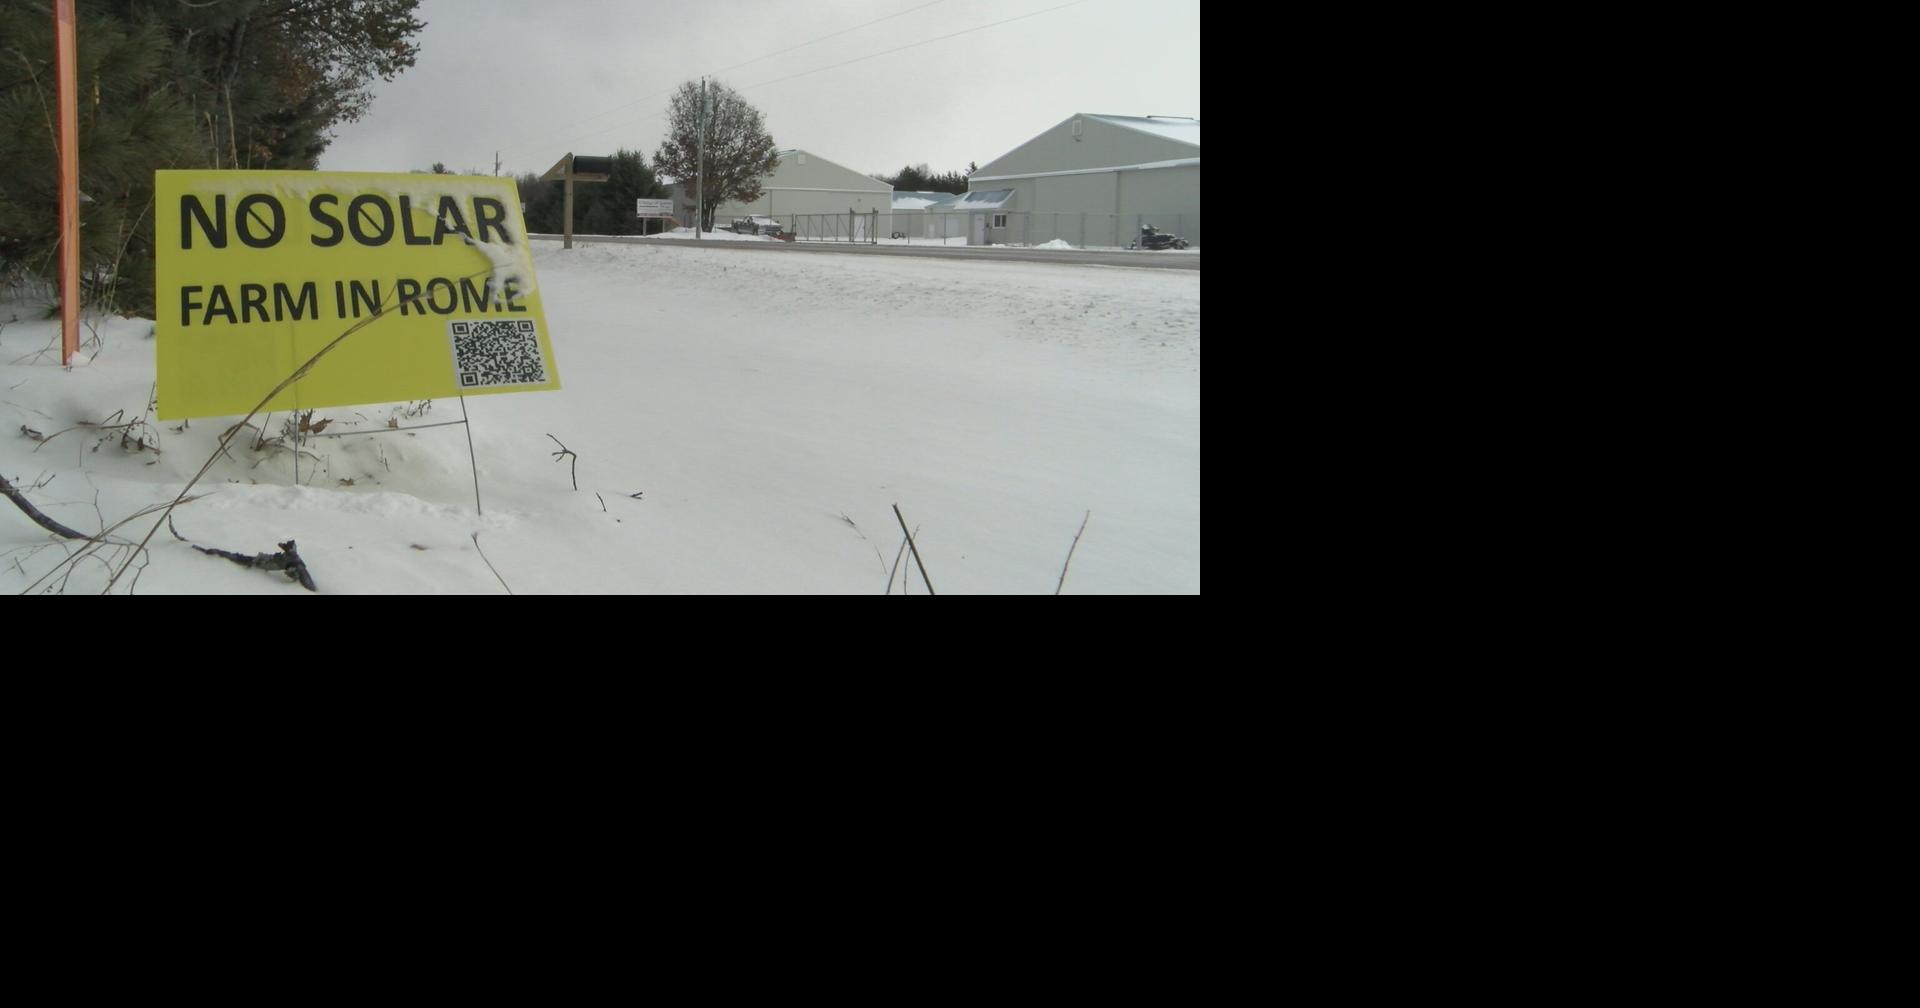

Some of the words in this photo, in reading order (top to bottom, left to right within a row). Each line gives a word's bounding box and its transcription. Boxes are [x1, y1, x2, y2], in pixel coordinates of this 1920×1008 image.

[180, 193, 286, 250] NO
[308, 193, 514, 248] SOLAR
[180, 281, 320, 327] FARM
[335, 279, 383, 319] IN
[397, 276, 528, 316] ROME
